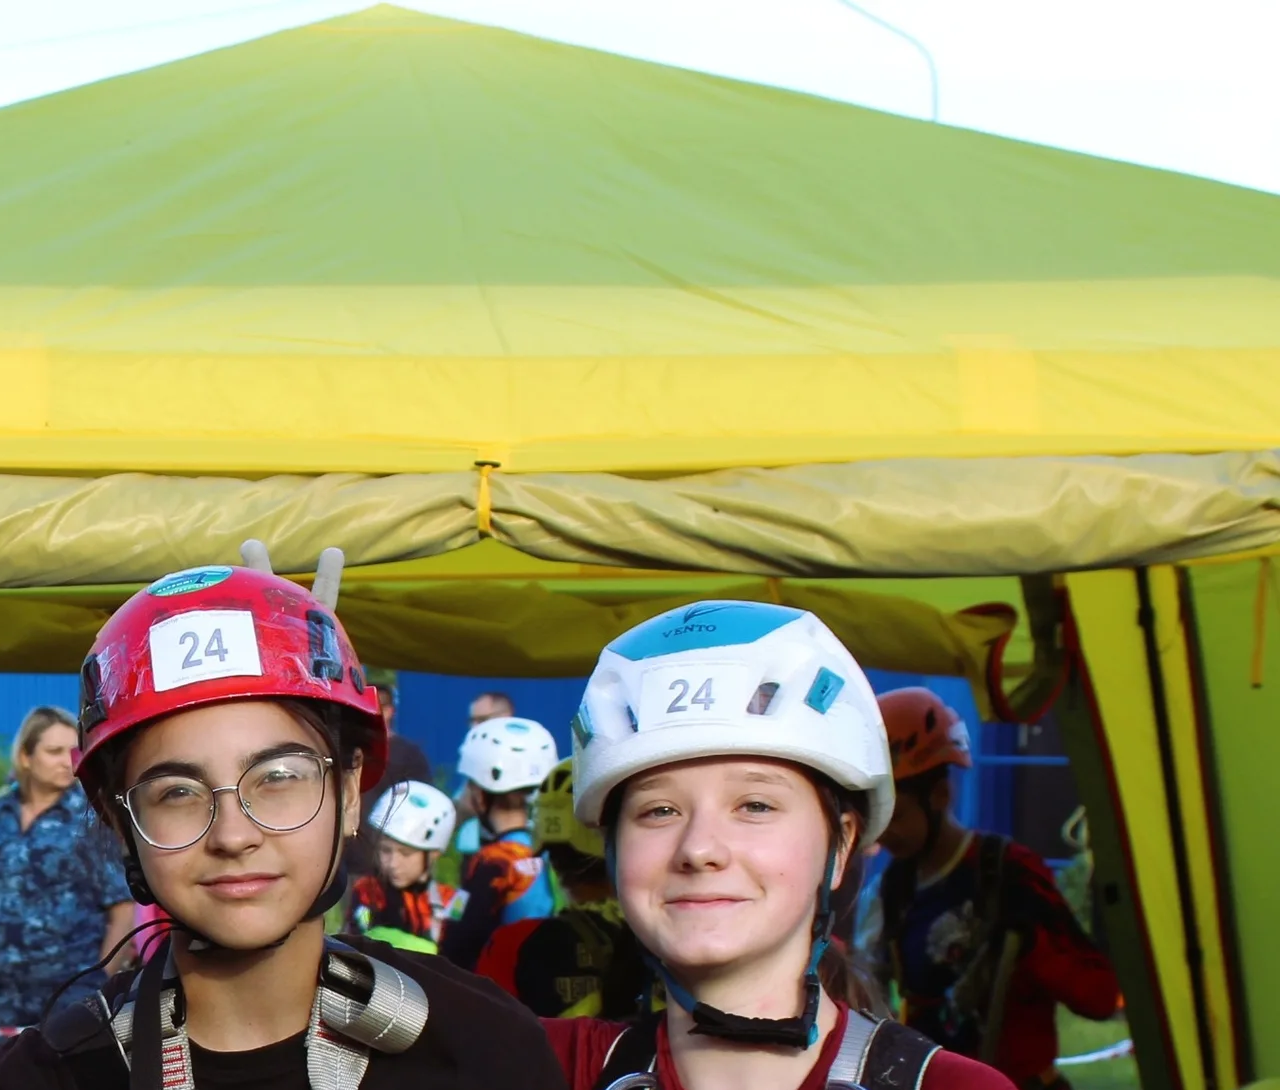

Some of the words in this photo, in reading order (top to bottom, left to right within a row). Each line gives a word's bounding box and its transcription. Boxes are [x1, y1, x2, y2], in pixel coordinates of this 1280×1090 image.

[179, 627, 229, 670] 24
[662, 624, 717, 638] VENTO
[666, 677, 716, 714] 24
